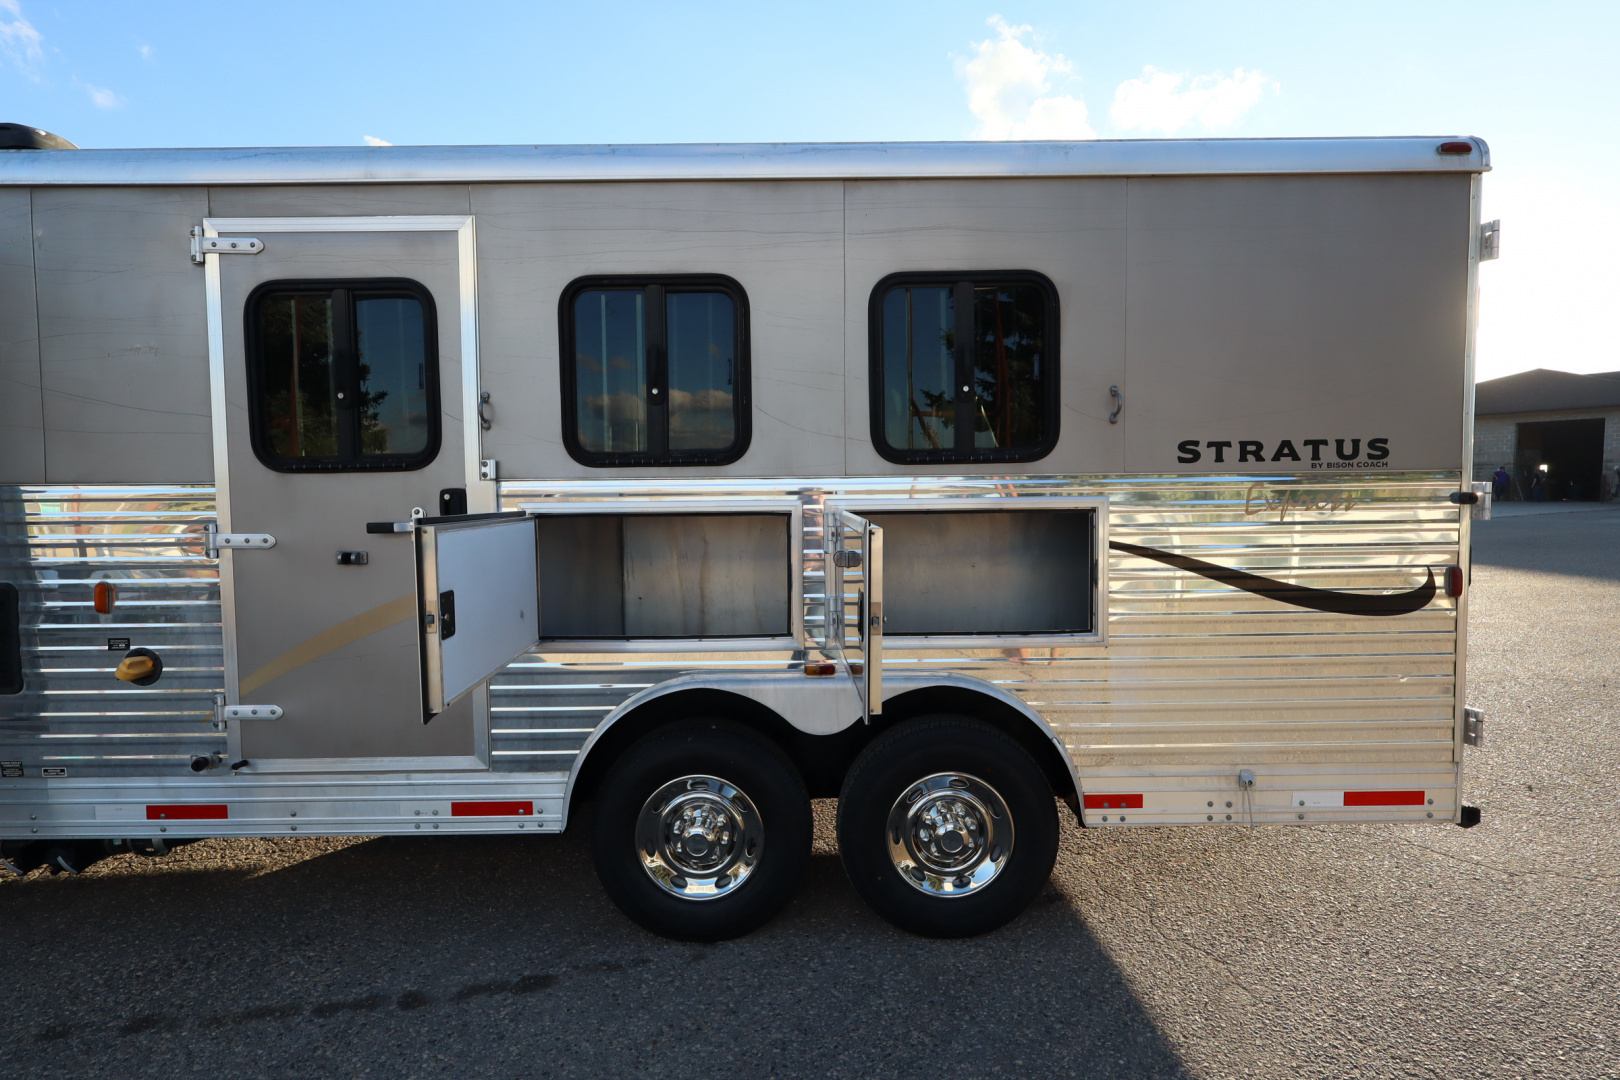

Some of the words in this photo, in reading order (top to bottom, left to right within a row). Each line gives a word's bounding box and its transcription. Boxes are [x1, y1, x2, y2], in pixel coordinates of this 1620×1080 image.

[1177, 438, 1390, 464] STRATUS
[1327, 461, 1354, 469] BISON
[1245, 482, 1358, 523] Express
